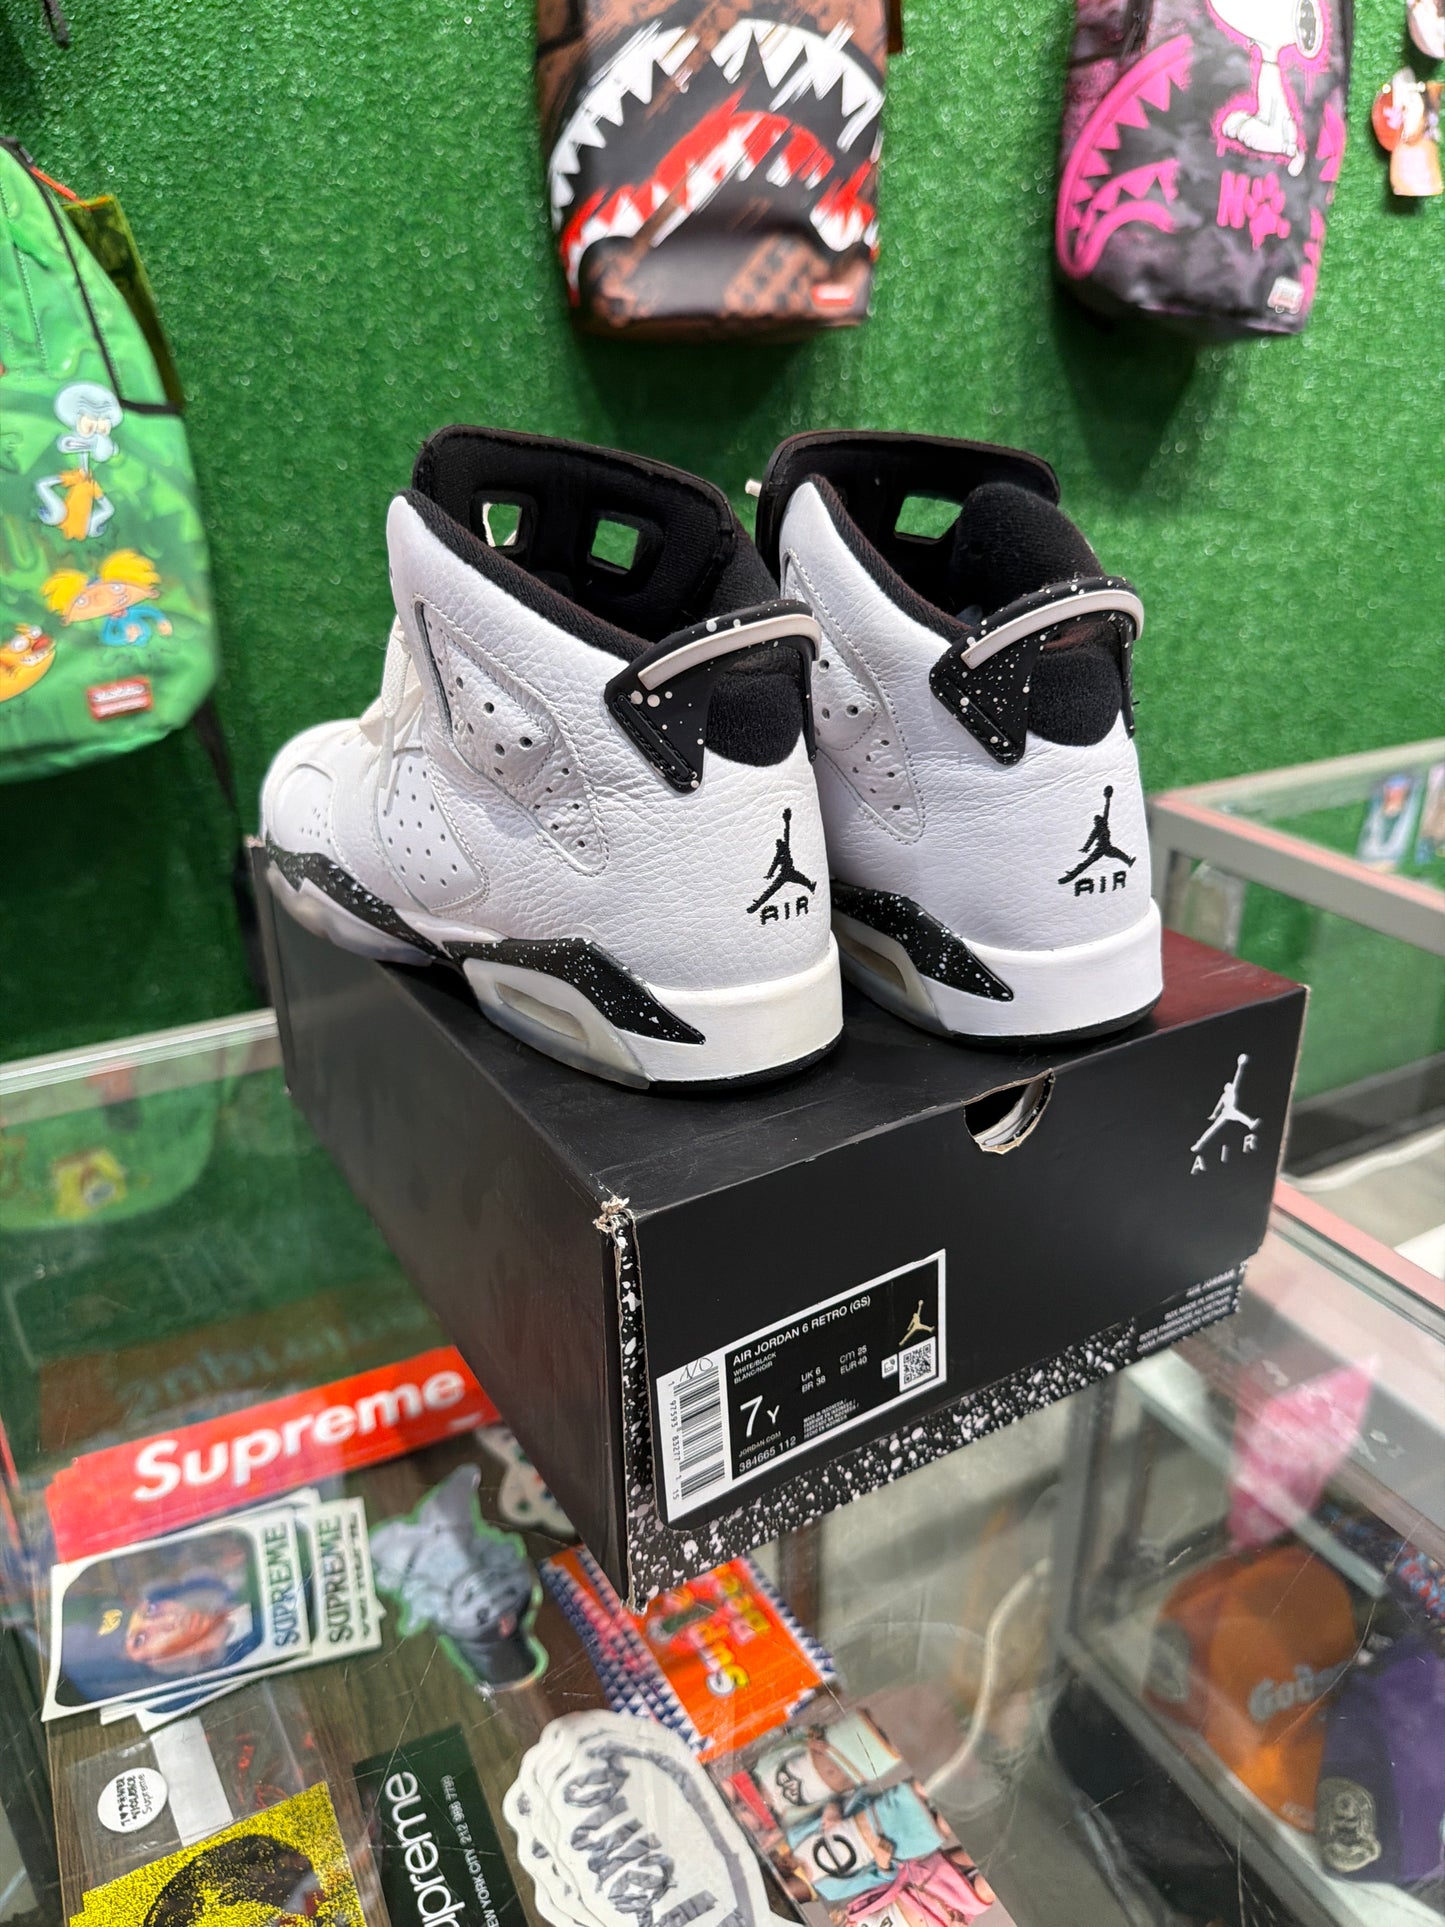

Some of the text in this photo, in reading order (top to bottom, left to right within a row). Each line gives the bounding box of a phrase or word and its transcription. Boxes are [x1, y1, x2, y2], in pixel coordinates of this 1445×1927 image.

[1074, 871, 1127, 897] AIR
[760, 896, 808, 925] AIR
[1190, 1133, 1257, 1175] AIR
[733, 1295, 871, 1366] AIR JORDAN 6 RETRO (GS)
[857, 1345, 867, 1356] 25
[733, 1352, 776, 1376] WHITE/BLACK
[734, 1360, 773, 1384] BLANC/NOIR
[801, 1367, 821, 1382] UK 6
[840, 1355, 868, 1375] EUR 40
[802, 1375, 826, 1393] BR 38
[669, 1400, 679, 1428] 97593
[132, 1369, 465, 1501] Supreme
[671, 1434, 681, 1462] 83277
[739, 1431, 781, 1457] JORDAN.COM
[739, 1435, 796, 1472] 384665 112
[672, 1488, 680, 1500] 15
[265, 1521, 300, 1647] SUPREME
[318, 1515, 353, 1643] SUPREME
[455, 1822, 472, 1846] 212
[385, 1771, 466, 1927] upreme
[464, 1848, 482, 1874] CITY
[473, 1872, 492, 1910] YORK
[483, 1908, 500, 1927] EW
